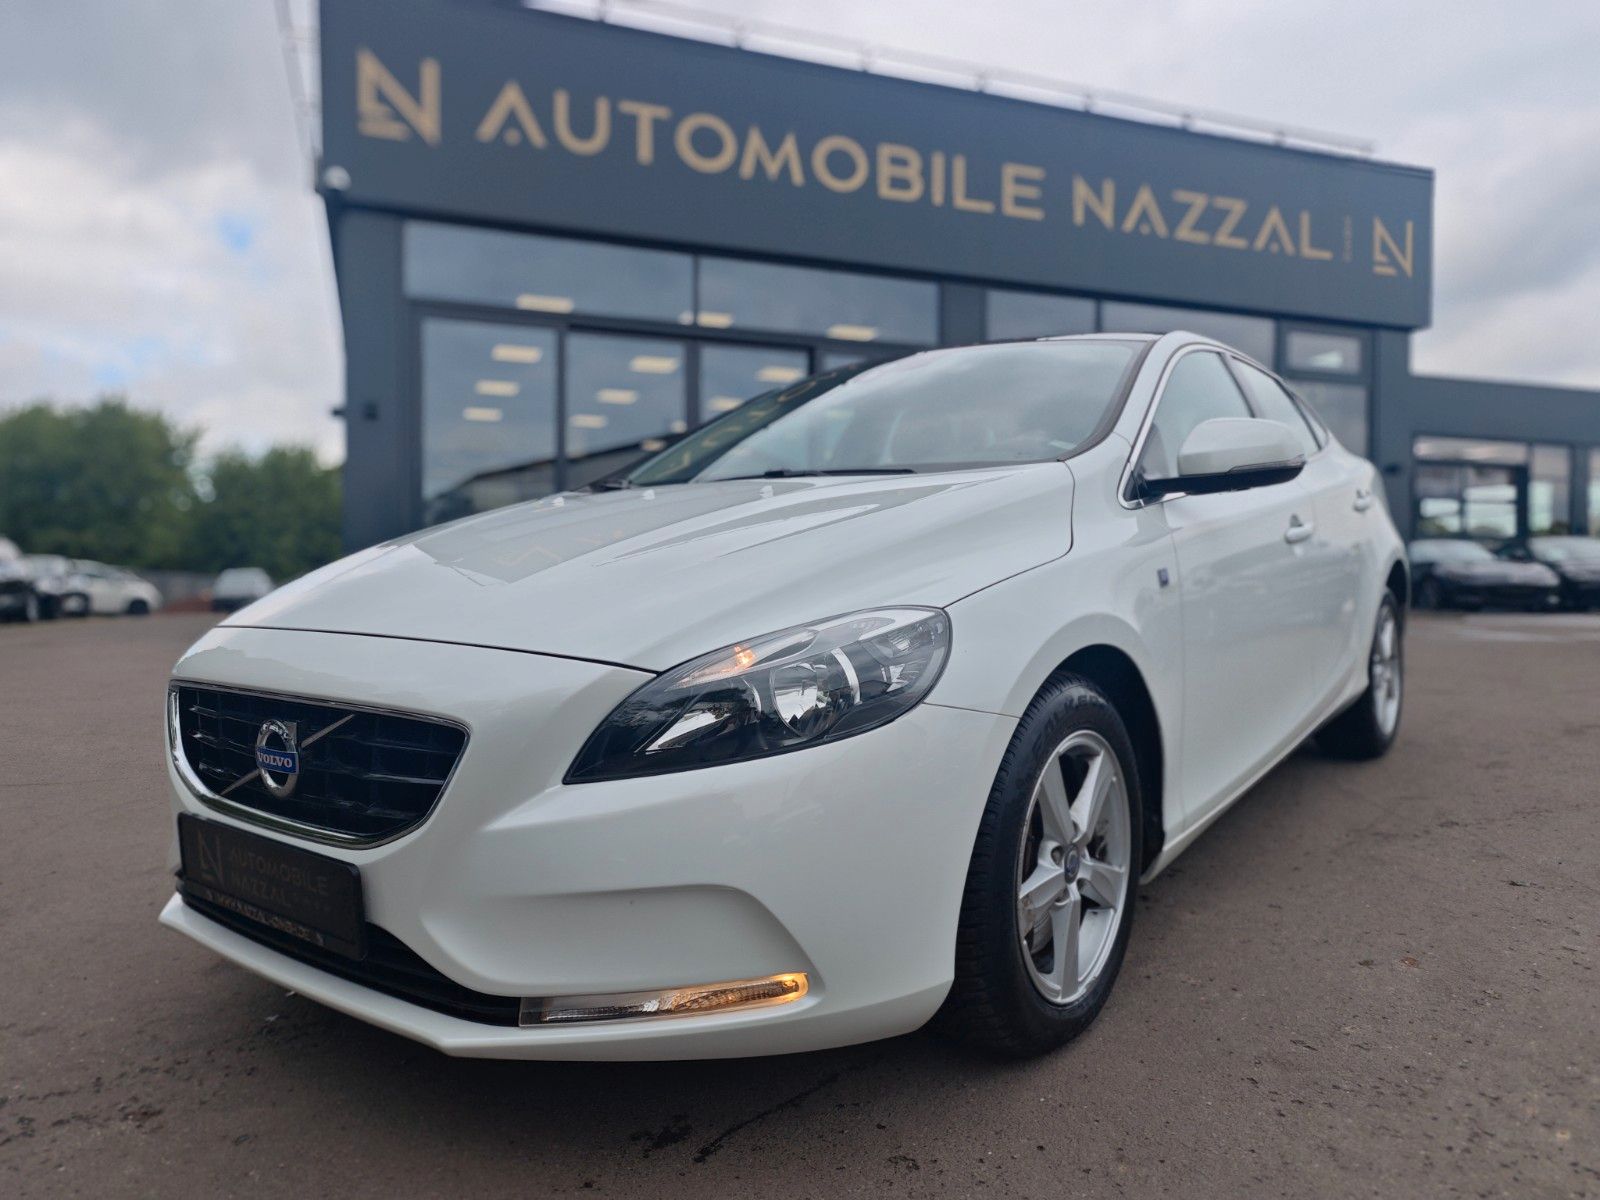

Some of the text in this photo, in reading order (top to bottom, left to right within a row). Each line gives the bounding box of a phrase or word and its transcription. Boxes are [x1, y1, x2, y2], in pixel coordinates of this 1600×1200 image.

[477, 82, 1044, 221] AUTOMOBILE
[1074, 177, 1333, 260] NAZZAL
[257, 751, 293, 768] VOLVO
[231, 845, 329, 896] AUTOMOBILE
